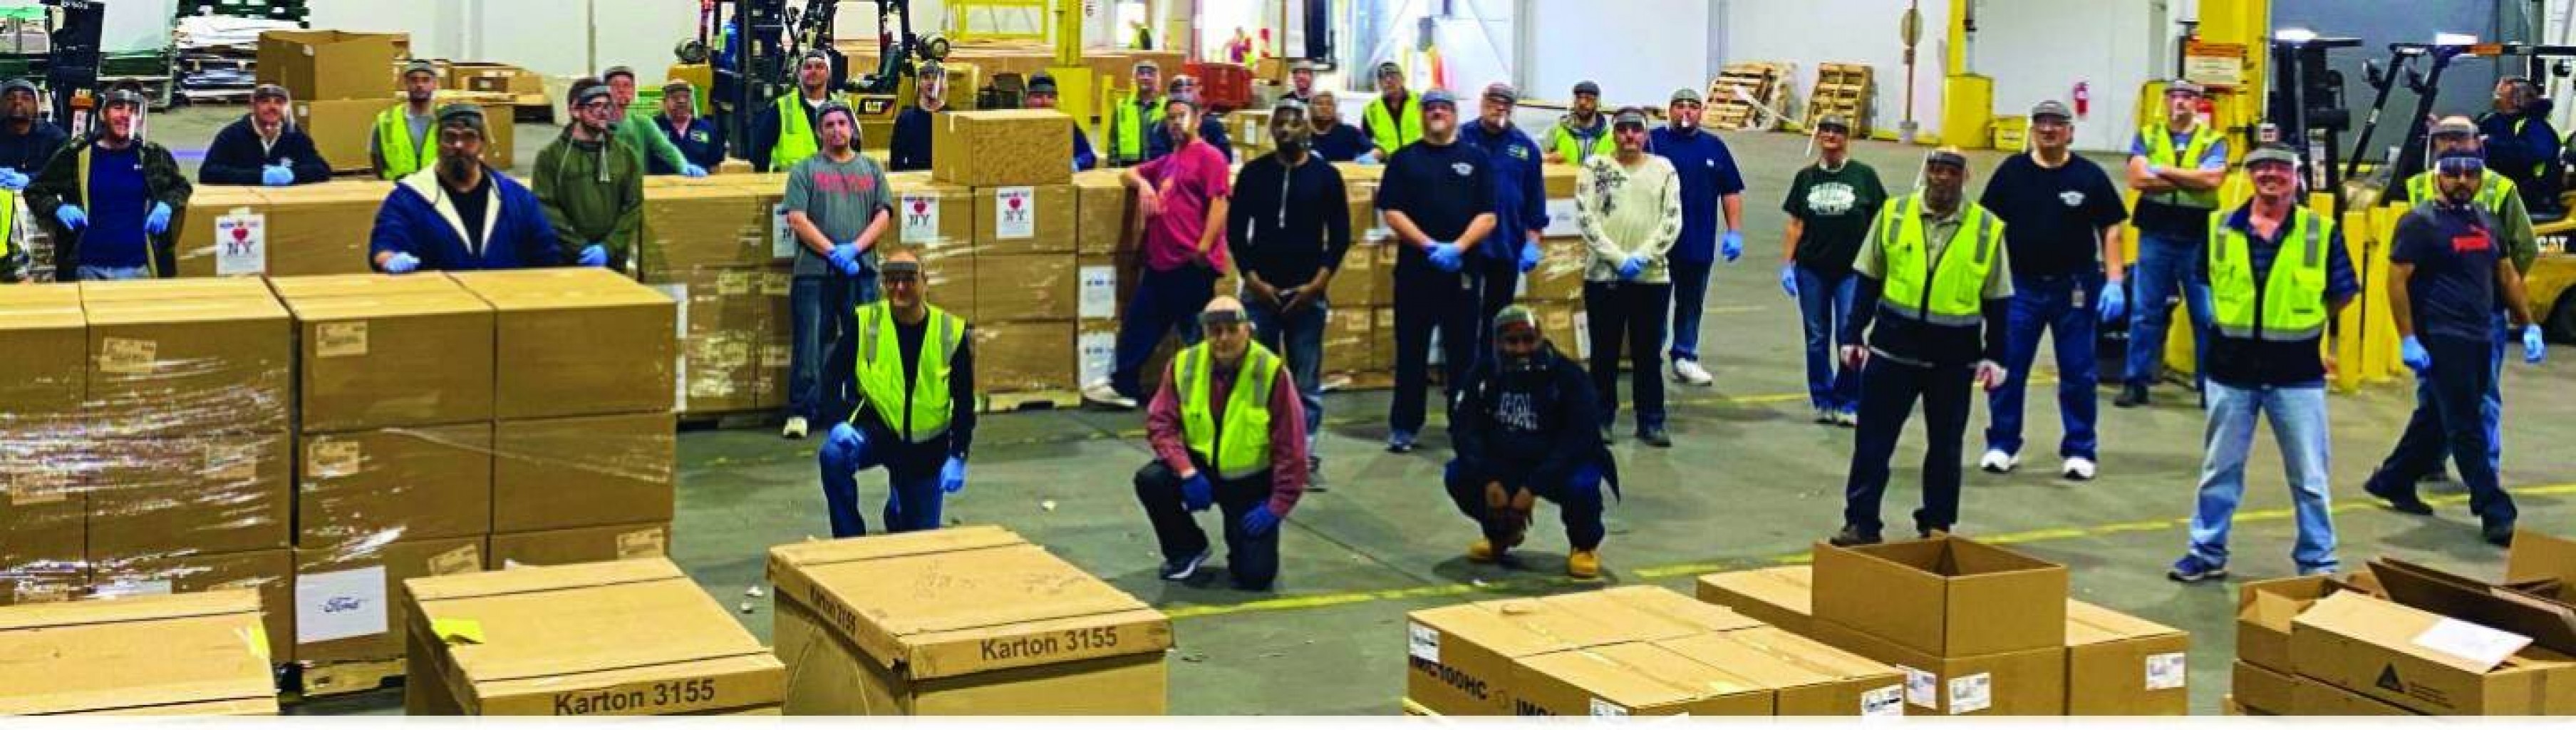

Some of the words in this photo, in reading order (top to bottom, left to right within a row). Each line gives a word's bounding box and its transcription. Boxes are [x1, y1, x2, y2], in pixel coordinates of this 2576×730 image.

[865, 101, 882, 113] CAT
[2536, 235, 2567, 253] CAT
[981, 637, 1057, 660] Karton
[1065, 626, 1117, 651] 3155
[554, 690, 644, 716] Karton
[653, 679, 715, 706] 3155
